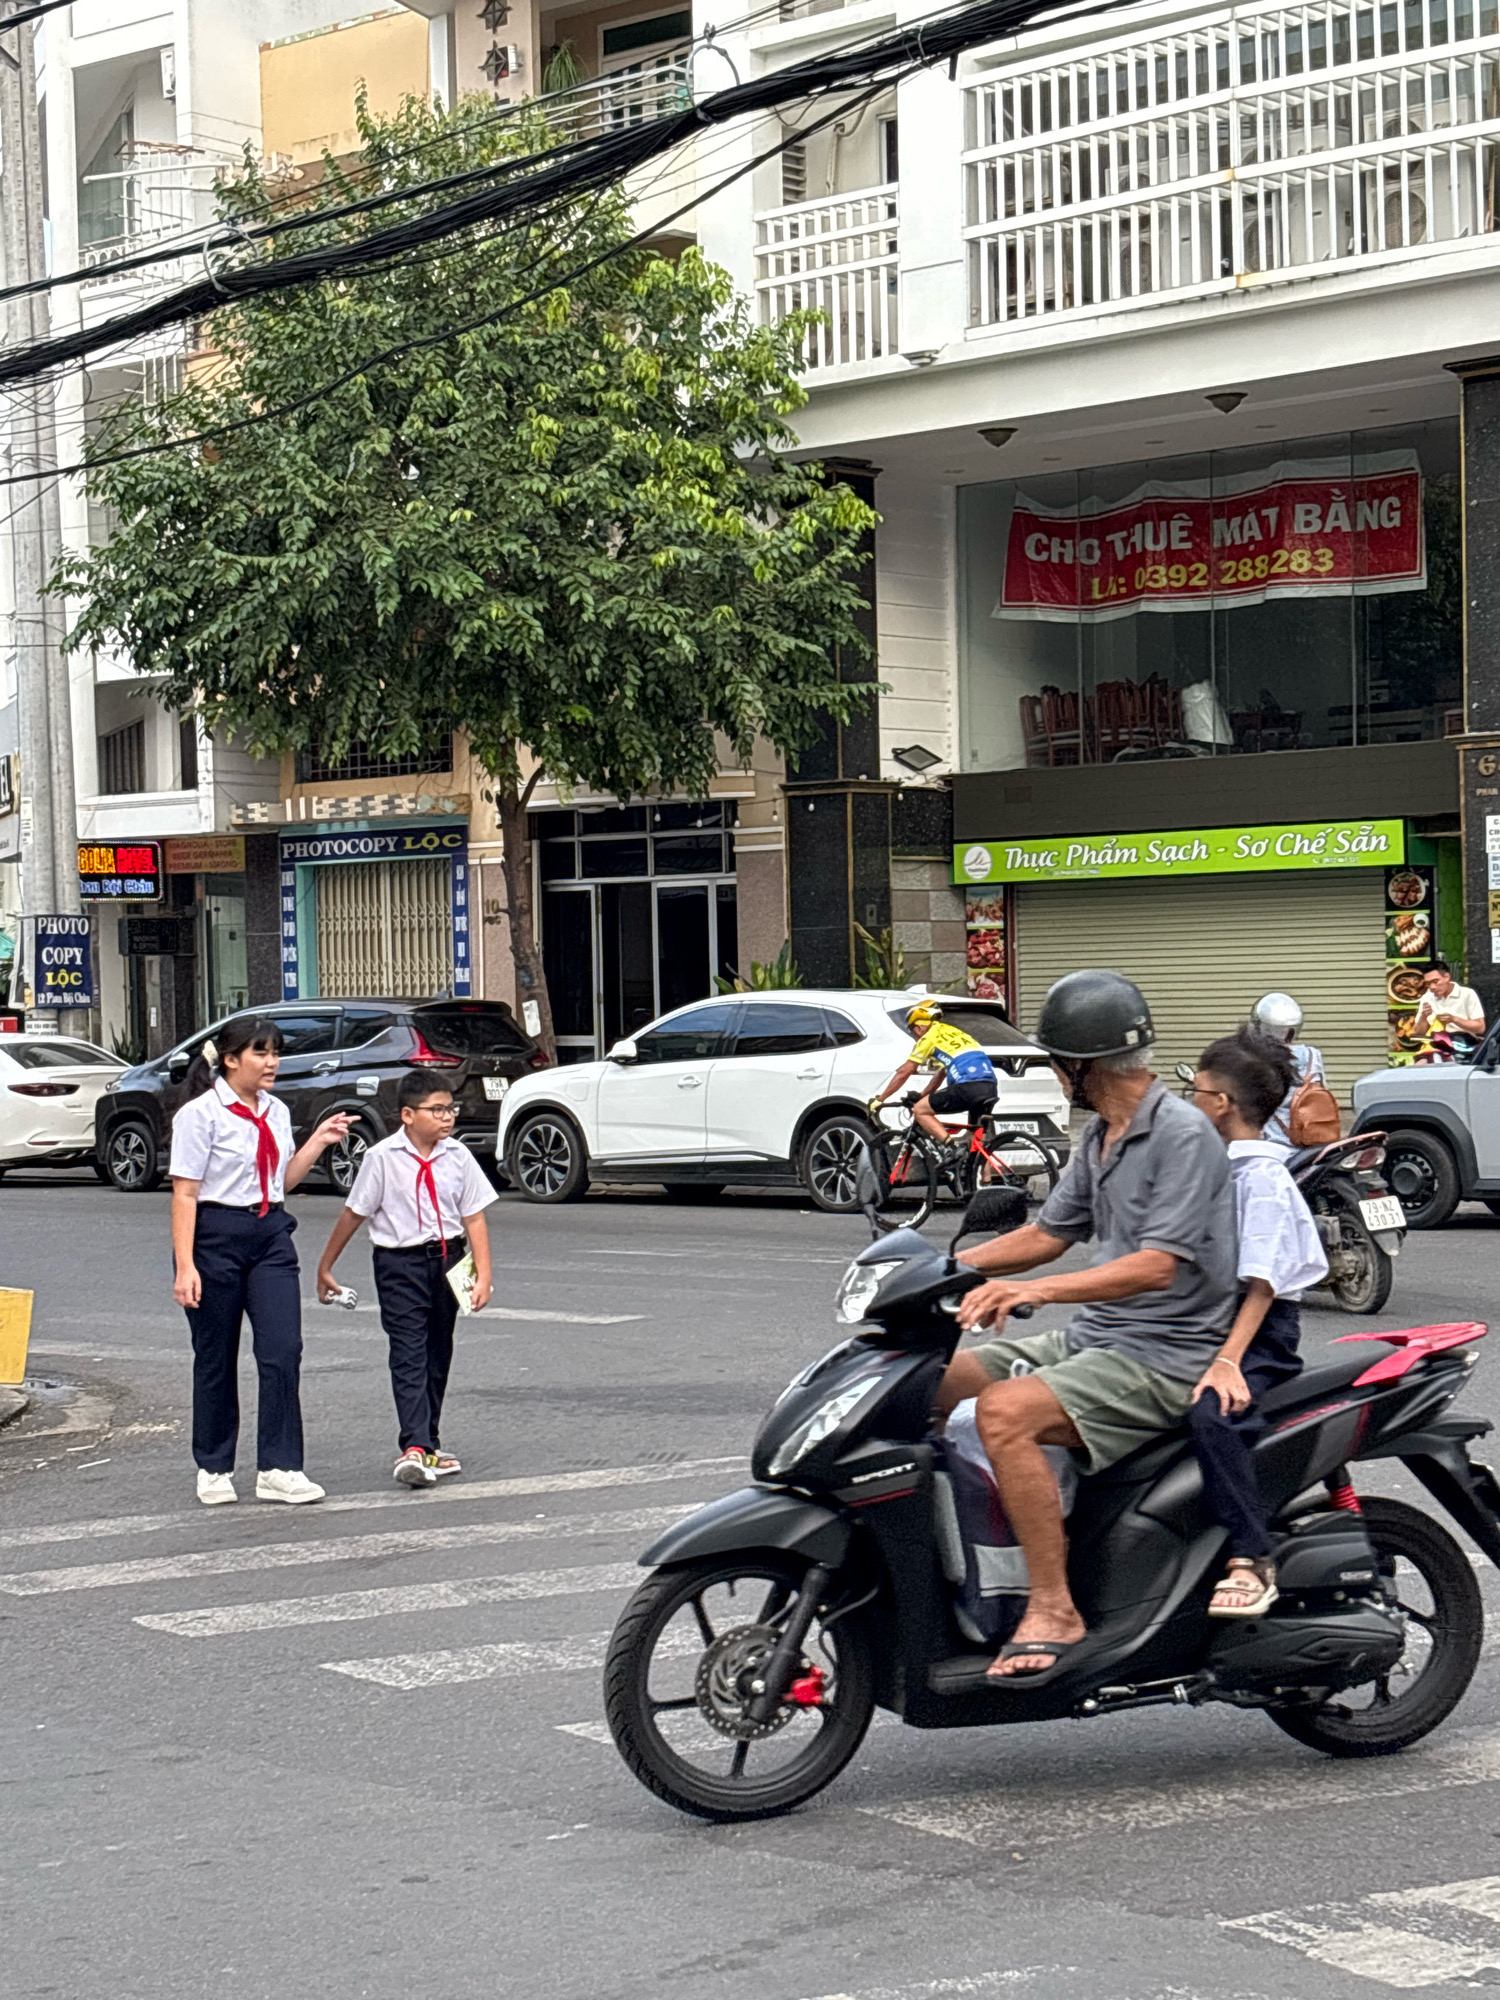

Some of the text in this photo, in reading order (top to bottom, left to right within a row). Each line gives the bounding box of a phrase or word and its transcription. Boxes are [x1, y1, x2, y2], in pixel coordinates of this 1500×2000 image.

[1024, 488, 1401, 566] CHO THUÊ MẶT BẰNG
[1134, 562, 1208, 590] 0392
[1219, 548, 1335, 585] 288283
[282, 832, 463, 860] PHOTOCOPY LỘC
[1004, 846, 1059, 873] Thực
[1066, 837, 1139, 867] Phẩm
[1144, 838, 1210, 867] Sạch
[1233, 835, 1270, 859] Sơ
[1275, 827, 1334, 857] Chế
[1333, 824, 1389, 854] Sẵn
[116, 847, 157, 874] HOTEL
[37, 917, 90, 936] PHOTO
[42, 946, 84, 966] COPY
[45, 968, 83, 989] LỘC
[851, 1462, 916, 1484] SPORT
